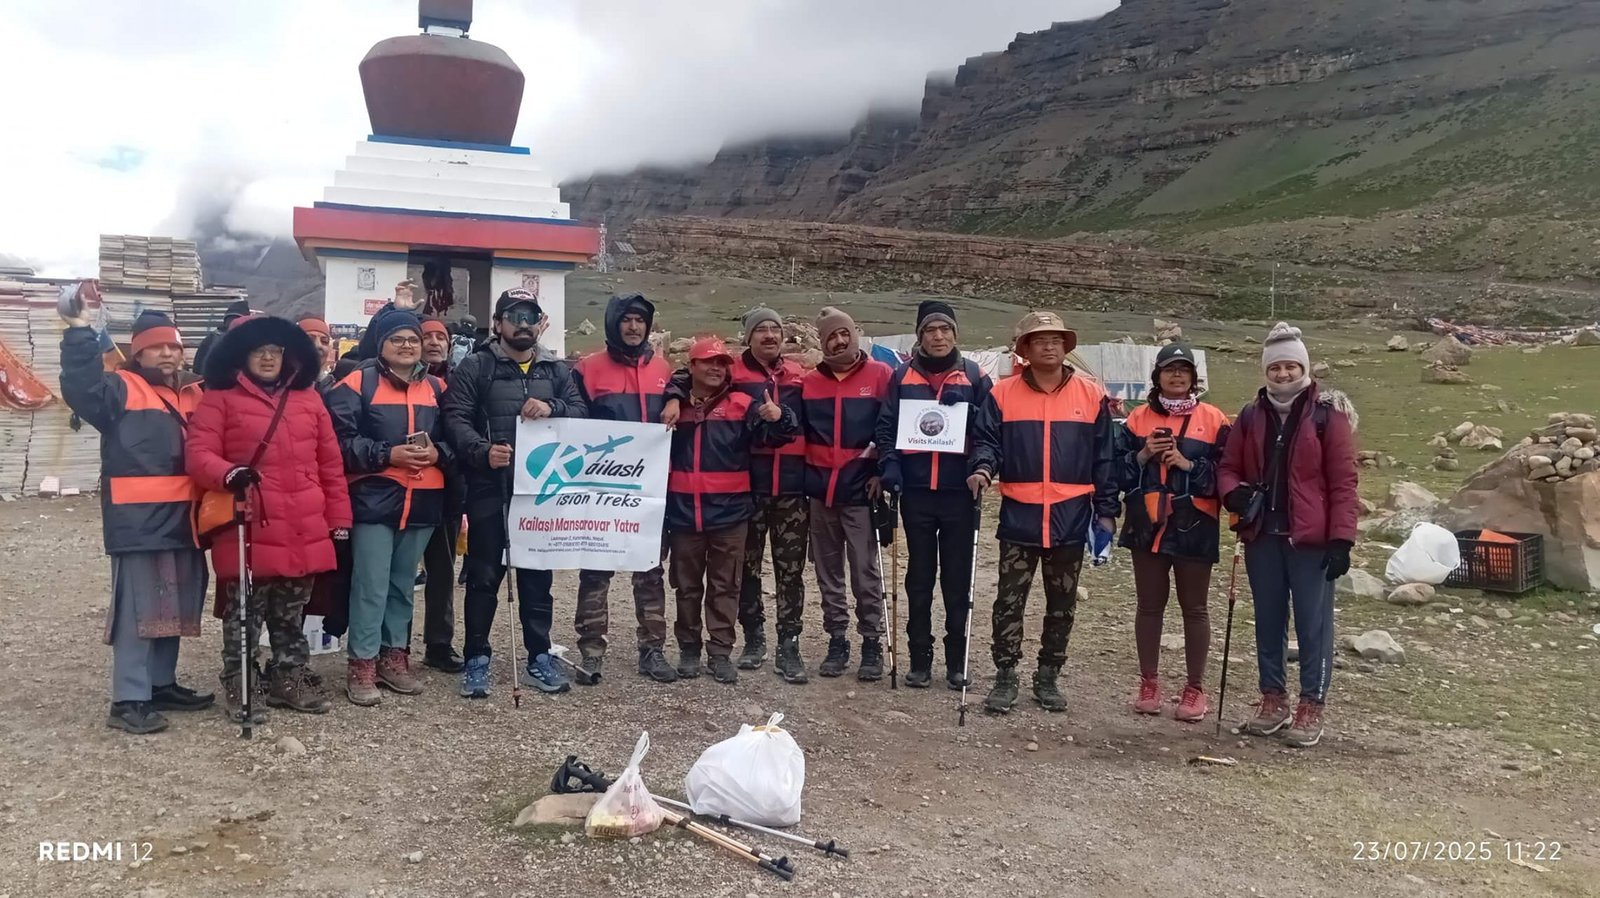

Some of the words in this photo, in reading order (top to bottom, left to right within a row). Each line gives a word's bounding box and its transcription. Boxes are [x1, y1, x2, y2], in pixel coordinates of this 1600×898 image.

[908, 437, 927, 445] Visits
[594, 492, 642, 508] Treks
[518, 516, 554, 533] Kailash
[554, 518, 611, 533] Mansarovar
[613, 518, 641, 533] Yatra
